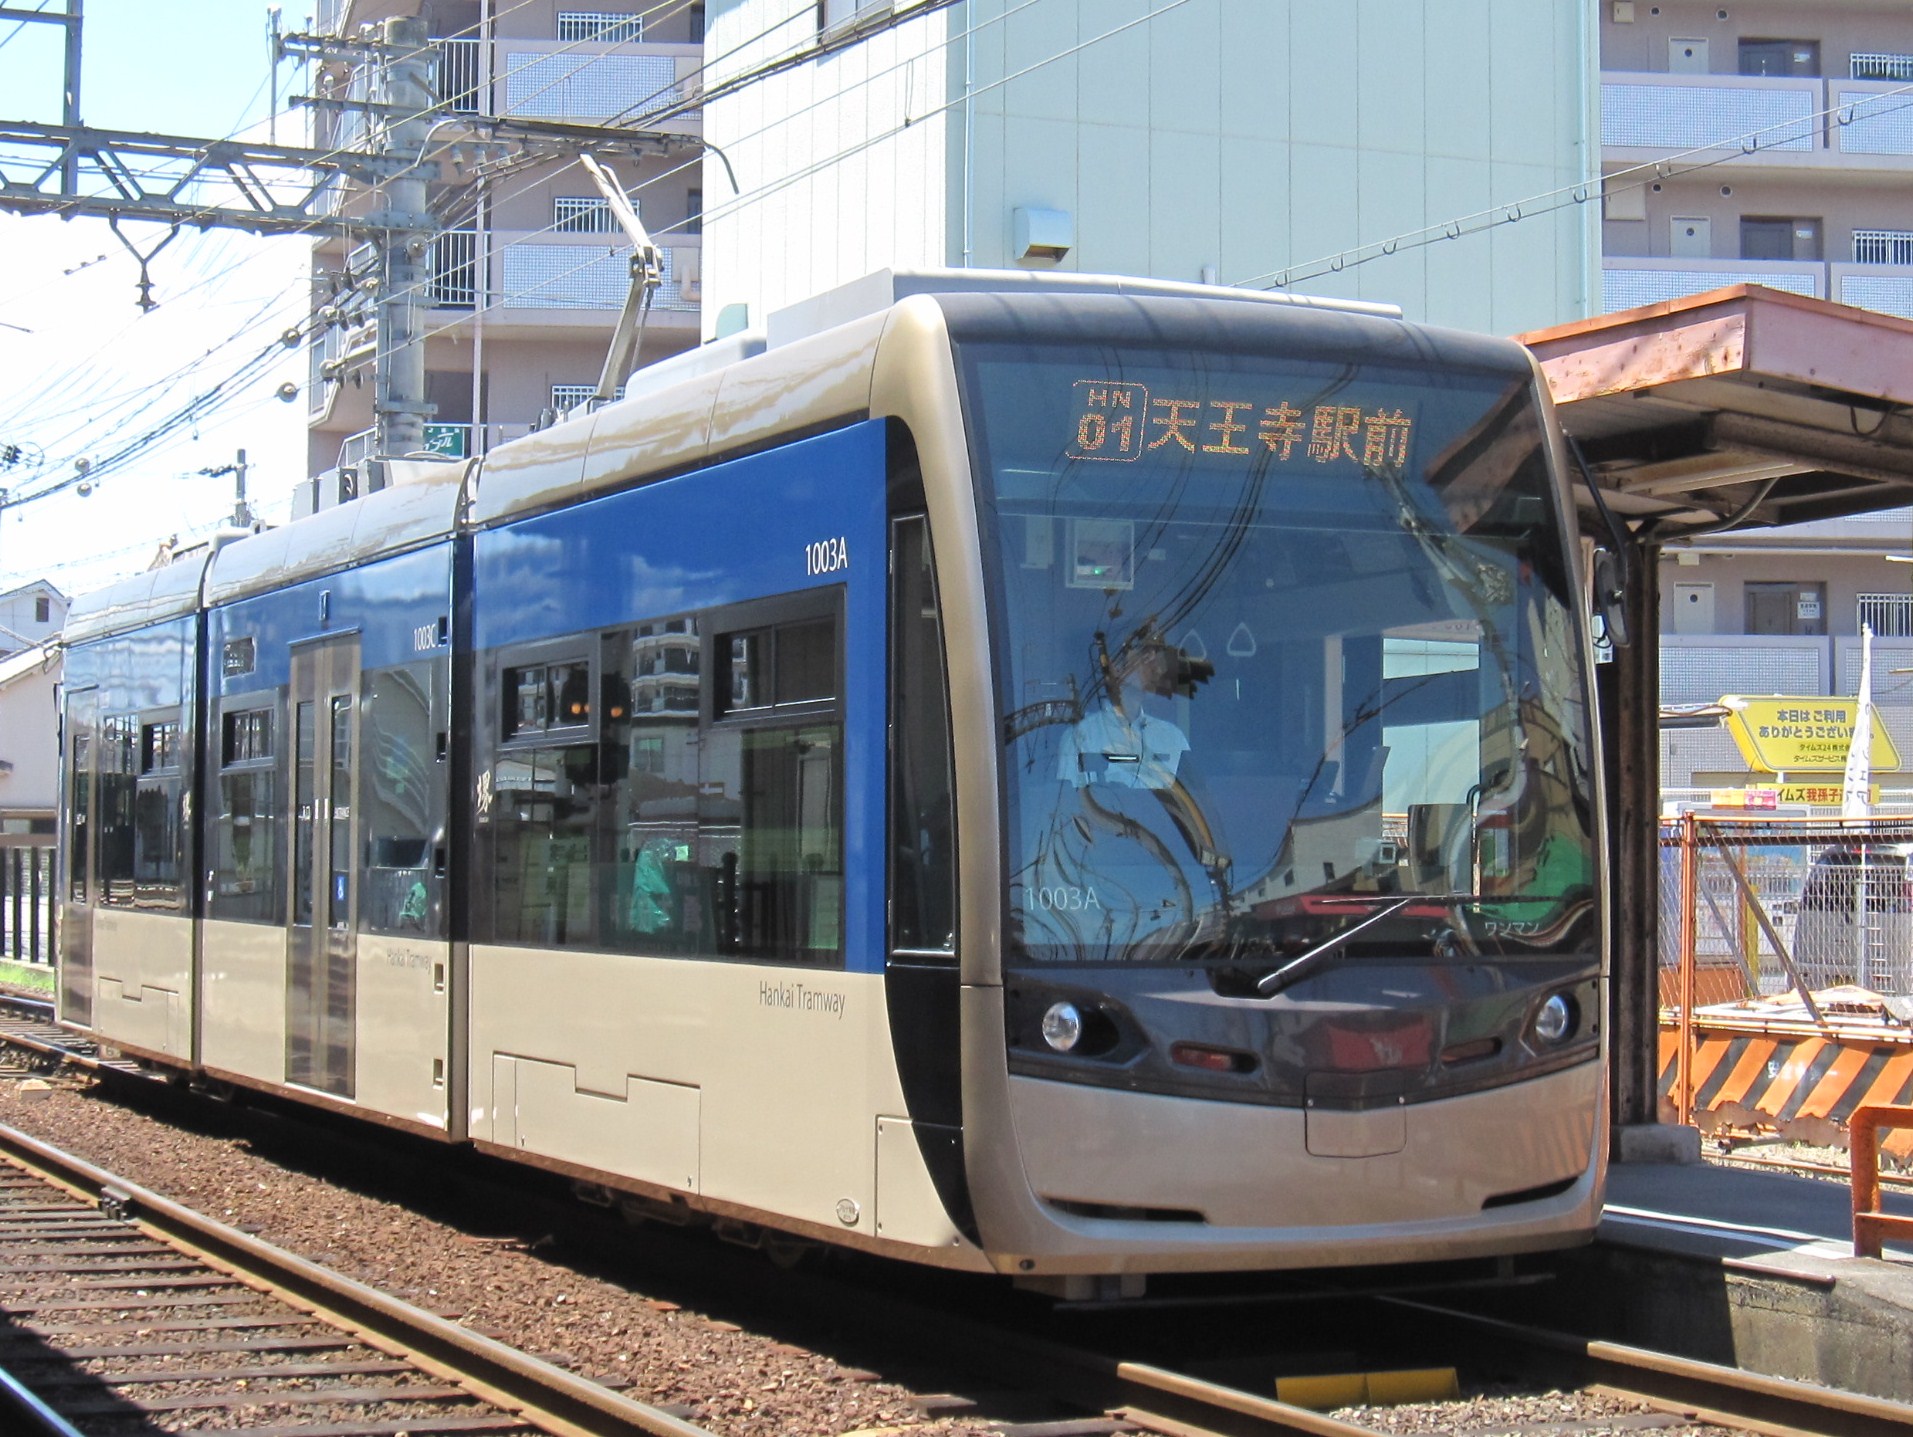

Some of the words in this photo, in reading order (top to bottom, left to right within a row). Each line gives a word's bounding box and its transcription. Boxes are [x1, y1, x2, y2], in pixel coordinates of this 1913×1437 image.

[1088, 387, 1132, 408] HN
[1076, 413, 1133, 452] 01
[1147, 397, 1413, 467] 天王寺駅前
[805, 536, 848, 576] 1003A
[413, 623, 436, 652] 1003C
[1774, 788, 1844, 803] イムズ我孫子
[1024, 886, 1102, 911] 1003A
[1484, 921, 1539, 937] ワンマン
[759, 980, 794, 1009] Hankai
[796, 983, 846, 1021] Tramway
